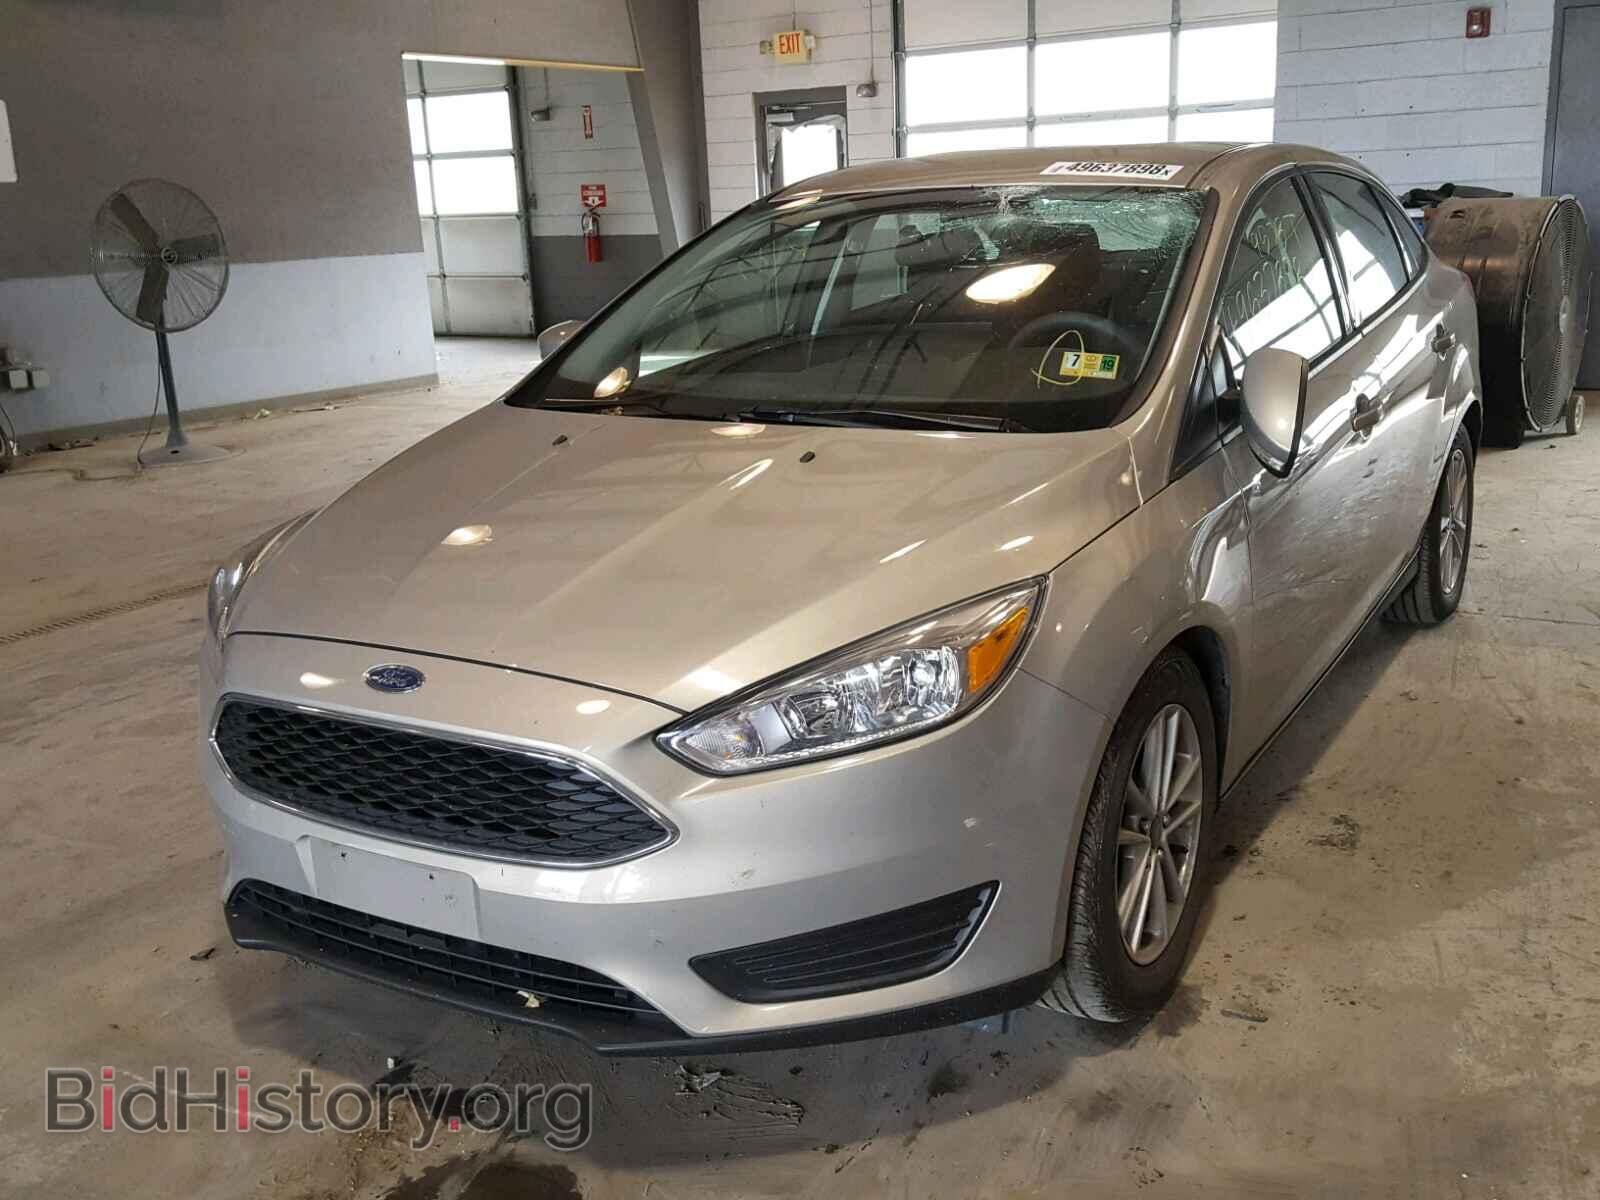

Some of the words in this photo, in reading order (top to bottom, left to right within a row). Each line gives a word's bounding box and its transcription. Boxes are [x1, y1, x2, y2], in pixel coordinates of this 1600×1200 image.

[779, 33, 801, 54] EXIT
[1065, 162, 1166, 175] 49637898
[1072, 354, 1081, 367] 7
